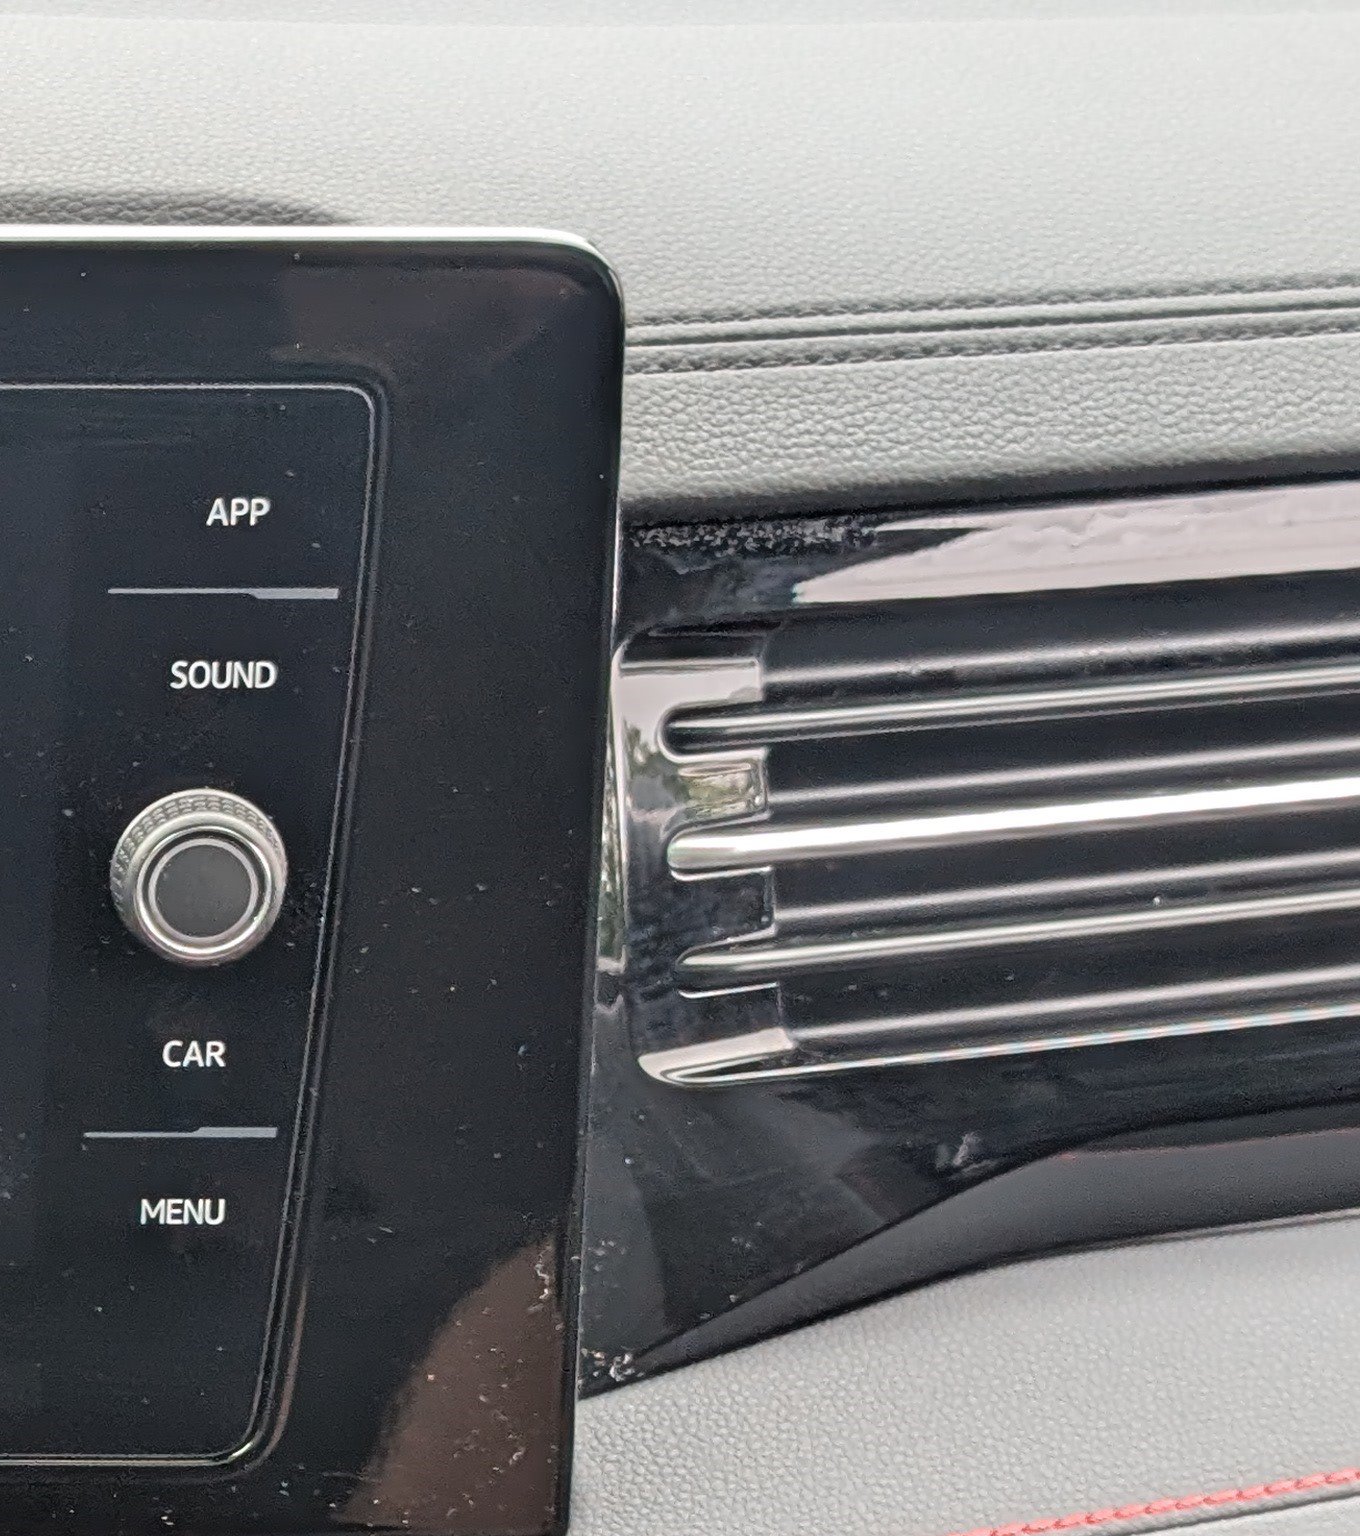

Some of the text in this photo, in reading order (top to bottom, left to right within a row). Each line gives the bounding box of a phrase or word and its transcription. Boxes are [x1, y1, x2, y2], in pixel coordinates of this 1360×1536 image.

[206, 497, 271, 527] APP
[169, 660, 278, 690] SOUND
[162, 1039, 226, 1068] CAR
[140, 1198, 226, 1226] MENU
